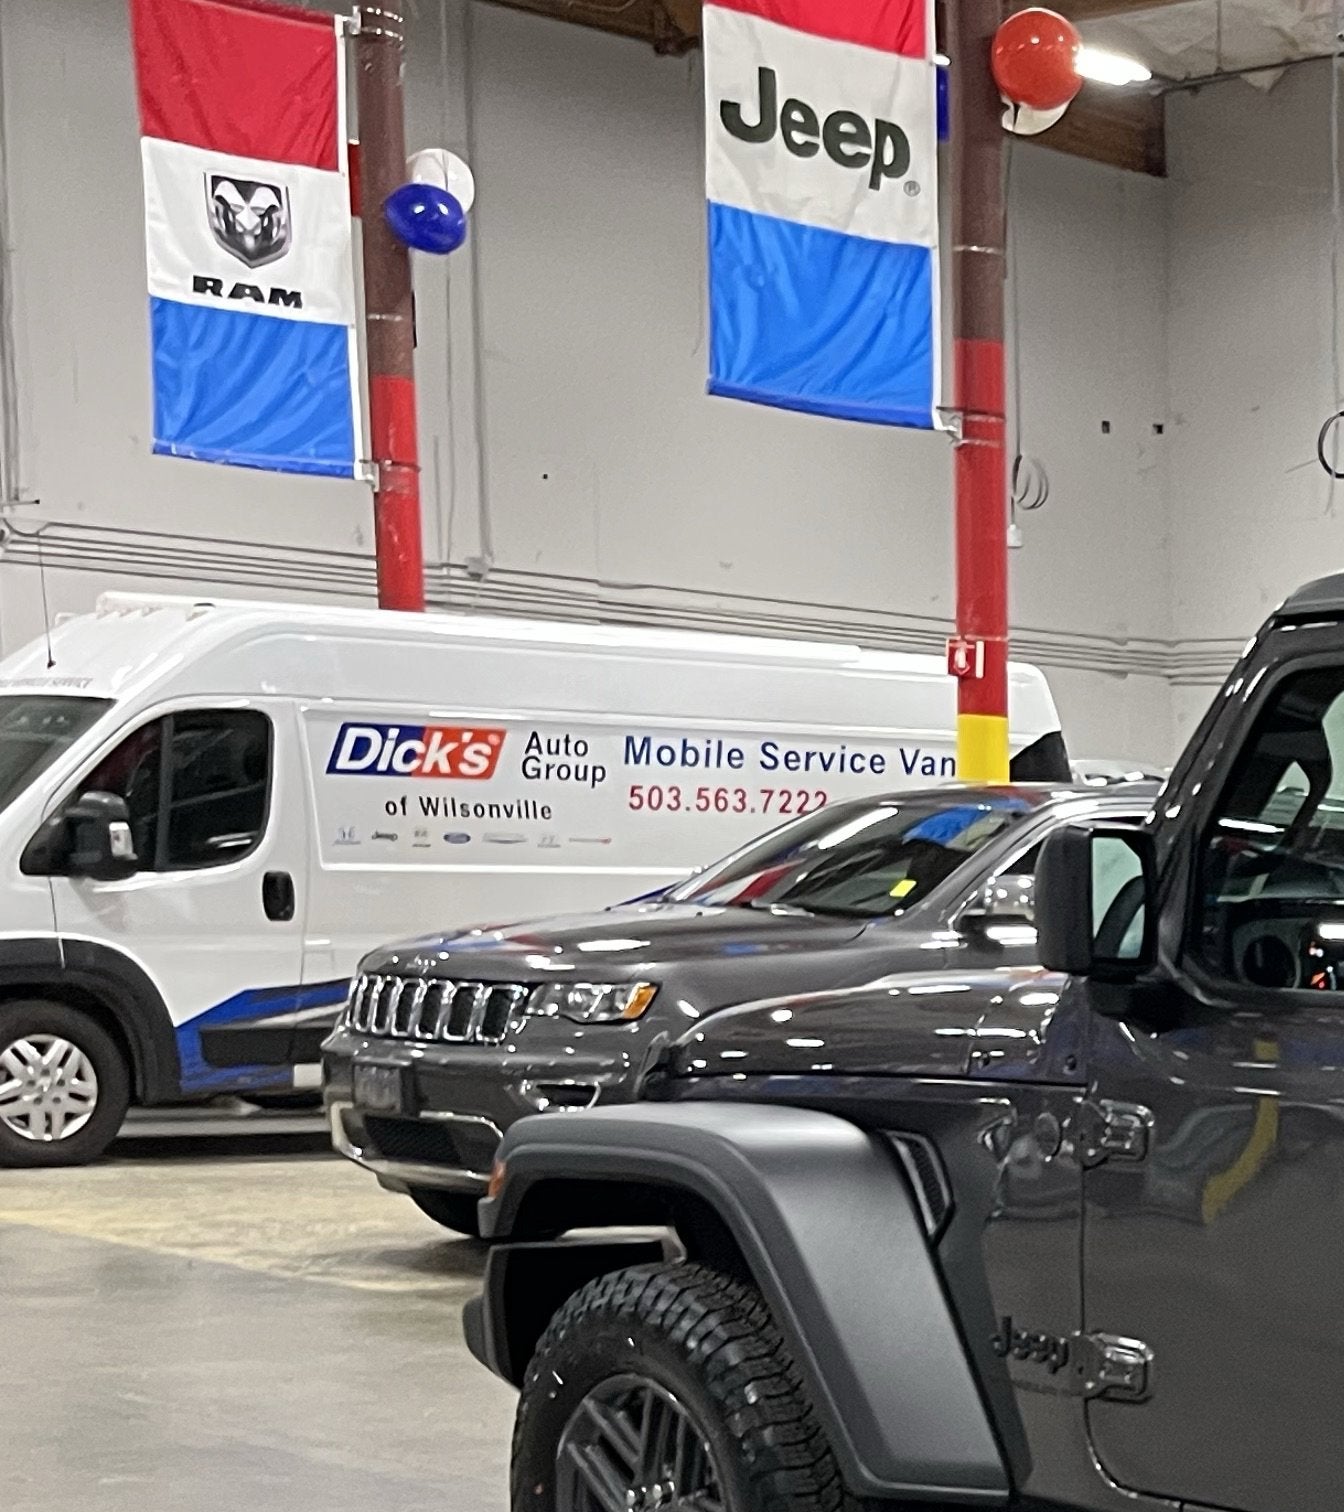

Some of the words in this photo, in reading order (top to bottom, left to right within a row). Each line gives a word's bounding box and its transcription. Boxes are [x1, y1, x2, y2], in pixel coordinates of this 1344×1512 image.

[720, 66, 911, 191] Jeep
[192, 274, 303, 309] RAM
[335, 726, 493, 777] Dick's
[524, 731, 589, 757] Auto
[623, 735, 745, 769] Mobile
[759, 741, 887, 774] Service
[899, 747, 957, 777] Van
[521, 755, 607, 788] Group
[384, 795, 408, 816] of
[418, 796, 553, 820] Wilsonville
[628, 785, 829, 815] 503.563.7222
[991, 1315, 1070, 1375] Jeep
